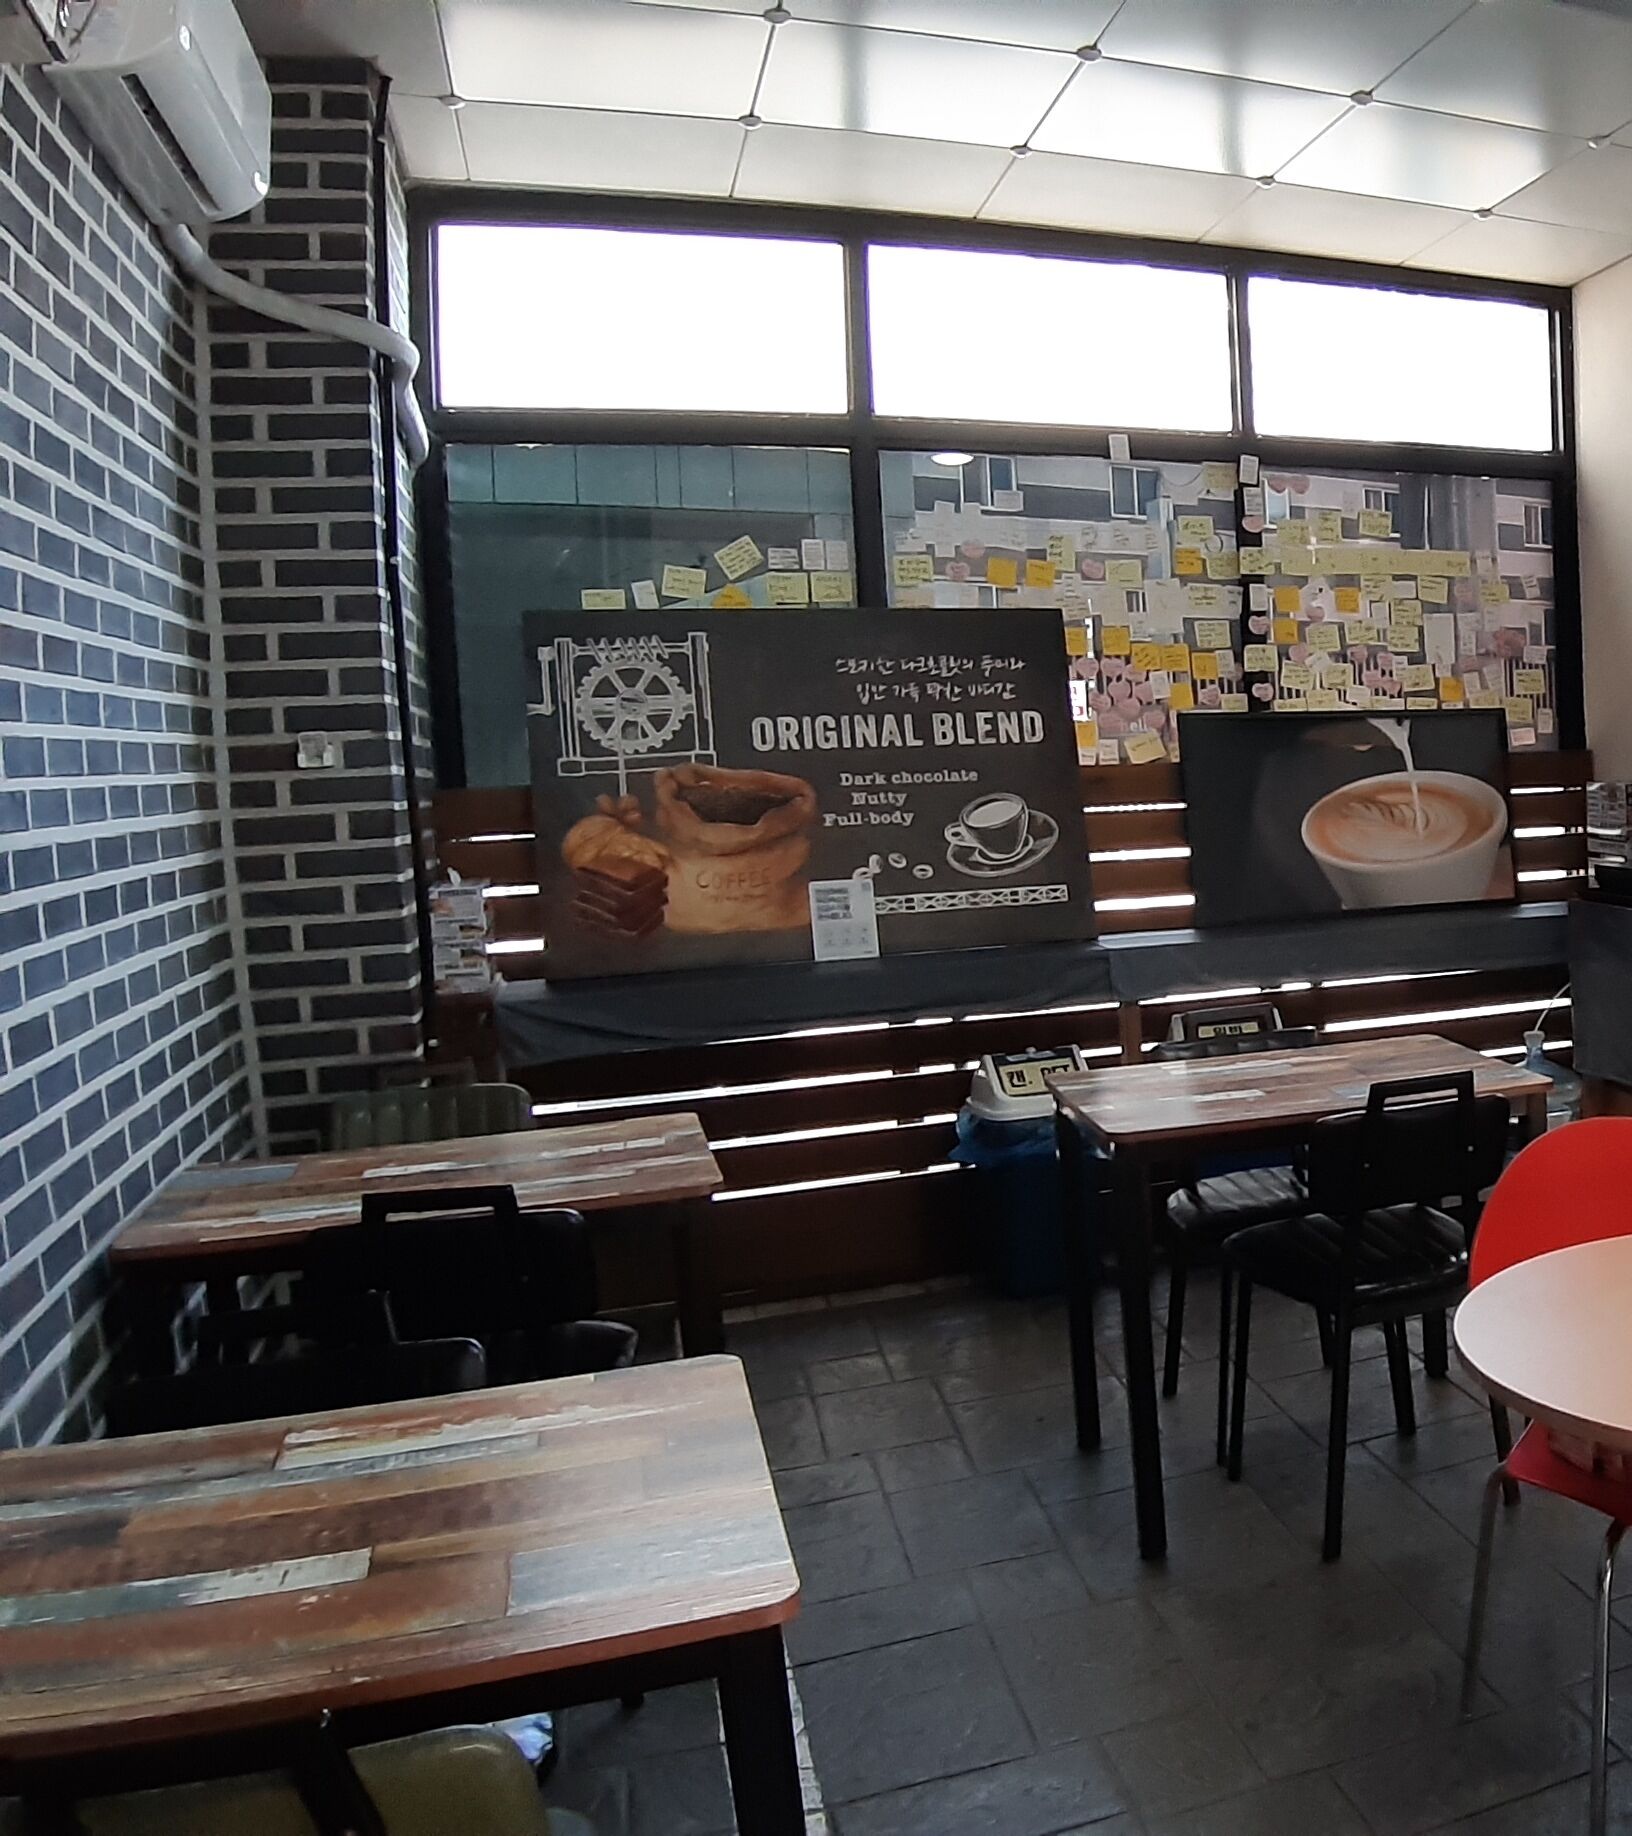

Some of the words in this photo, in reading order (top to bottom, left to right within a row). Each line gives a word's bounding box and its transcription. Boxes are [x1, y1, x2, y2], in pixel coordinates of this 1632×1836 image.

[751, 713, 924, 752] ORIGINAL
[931, 710, 1045, 746] BLEND
[840, 772, 887, 786] Dark
[891, 769, 979, 784] chocolate
[851, 791, 907, 807] Nutty
[823, 811, 914, 827] Full-body
